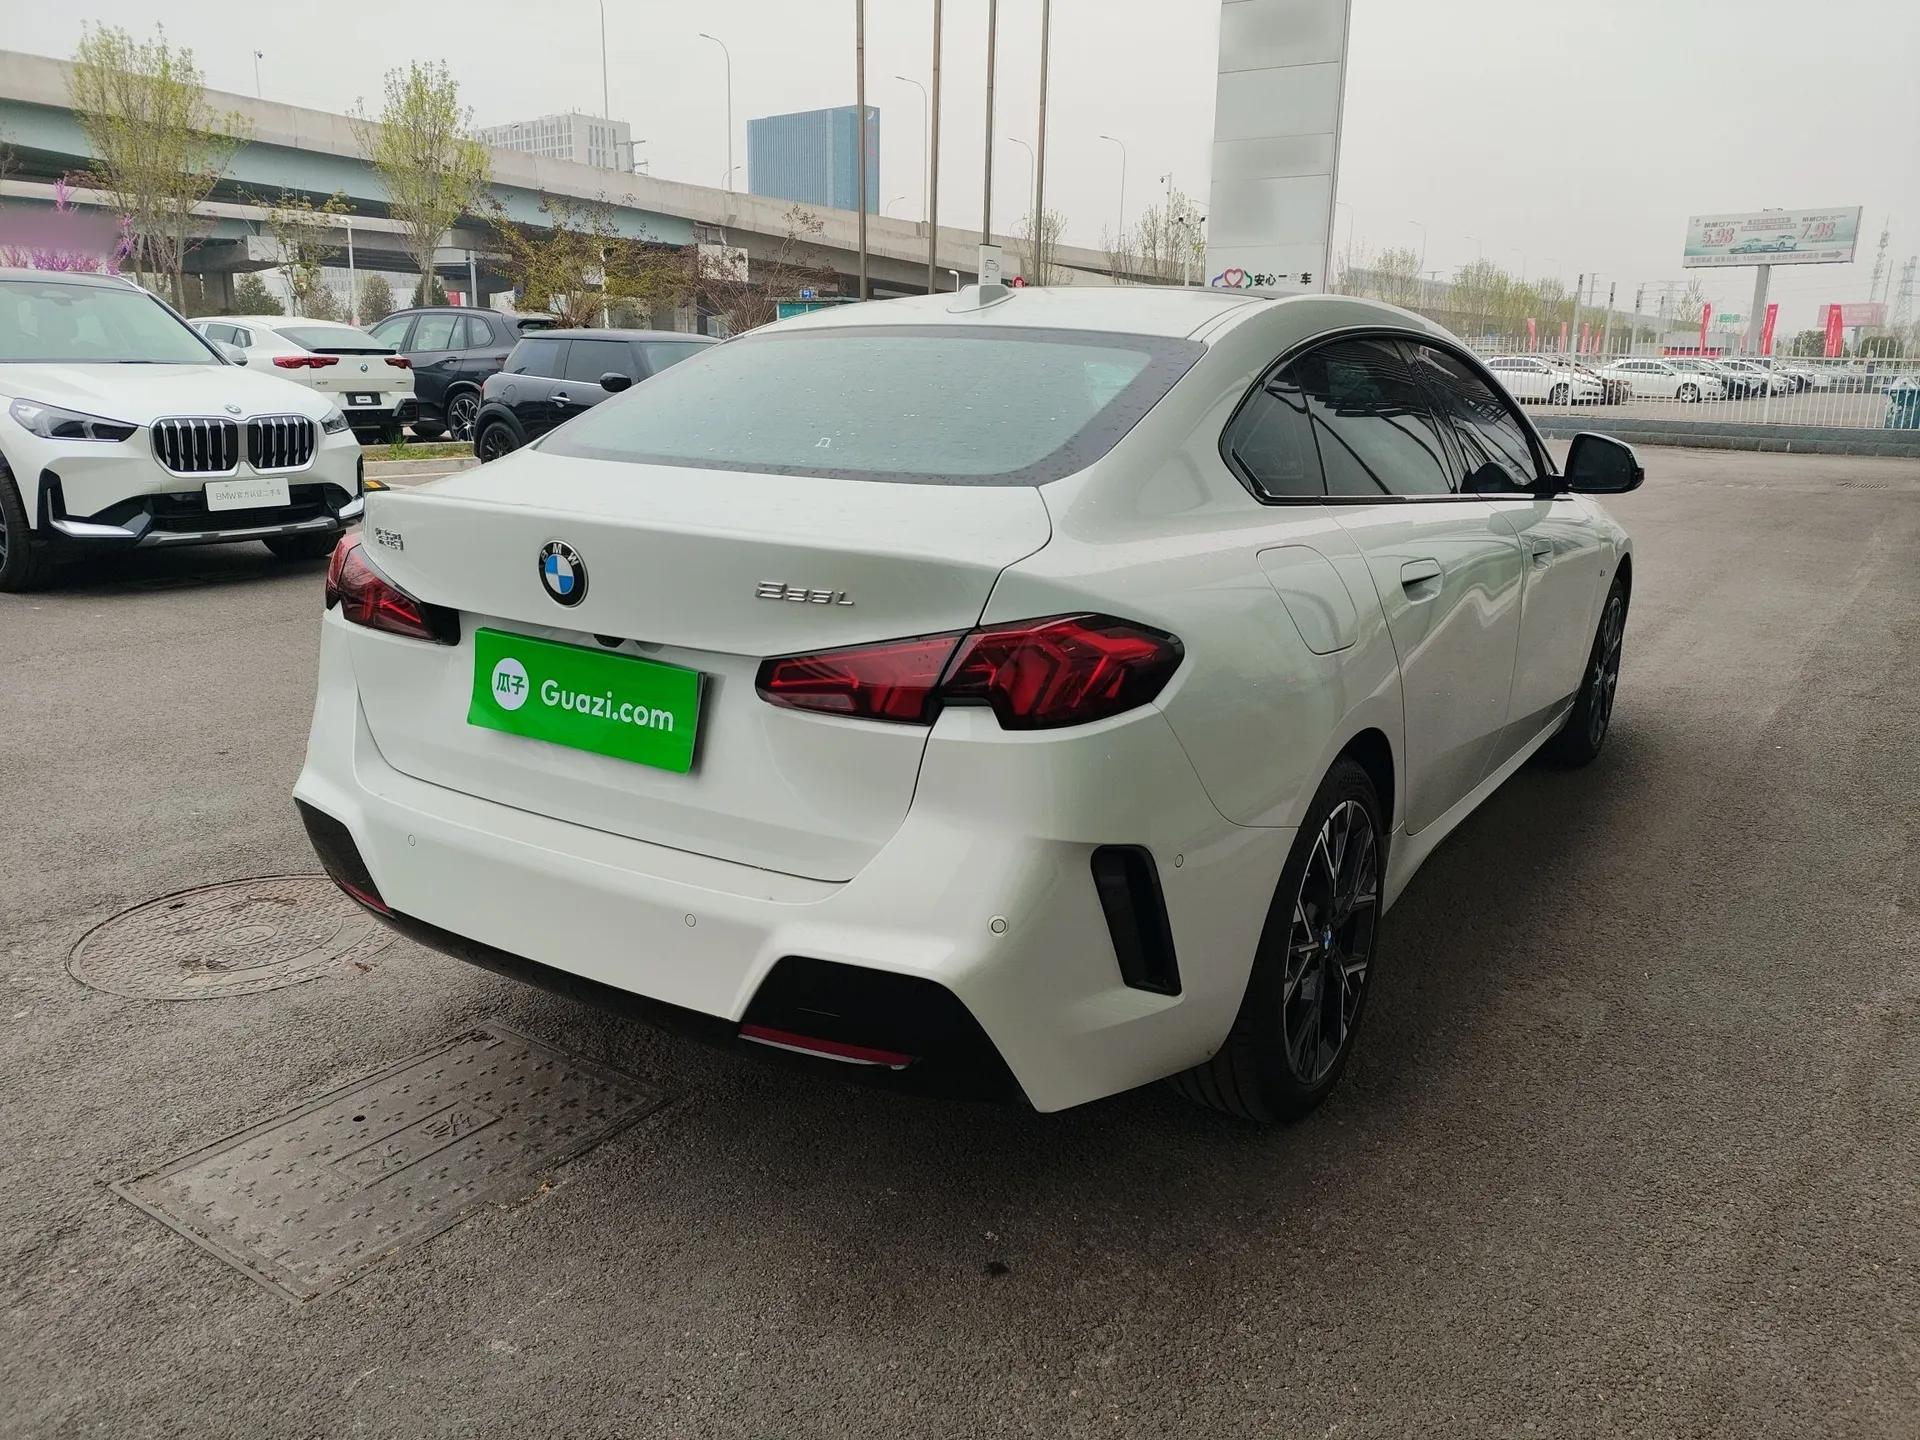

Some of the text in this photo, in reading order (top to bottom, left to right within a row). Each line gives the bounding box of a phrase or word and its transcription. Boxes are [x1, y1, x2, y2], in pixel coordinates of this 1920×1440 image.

[1254, 272, 1312, 286] 安心车
[541, 543, 579, 566] BMW
[496, 672, 525, 695] 瓜子
[541, 679, 674, 732] Guazi.com
